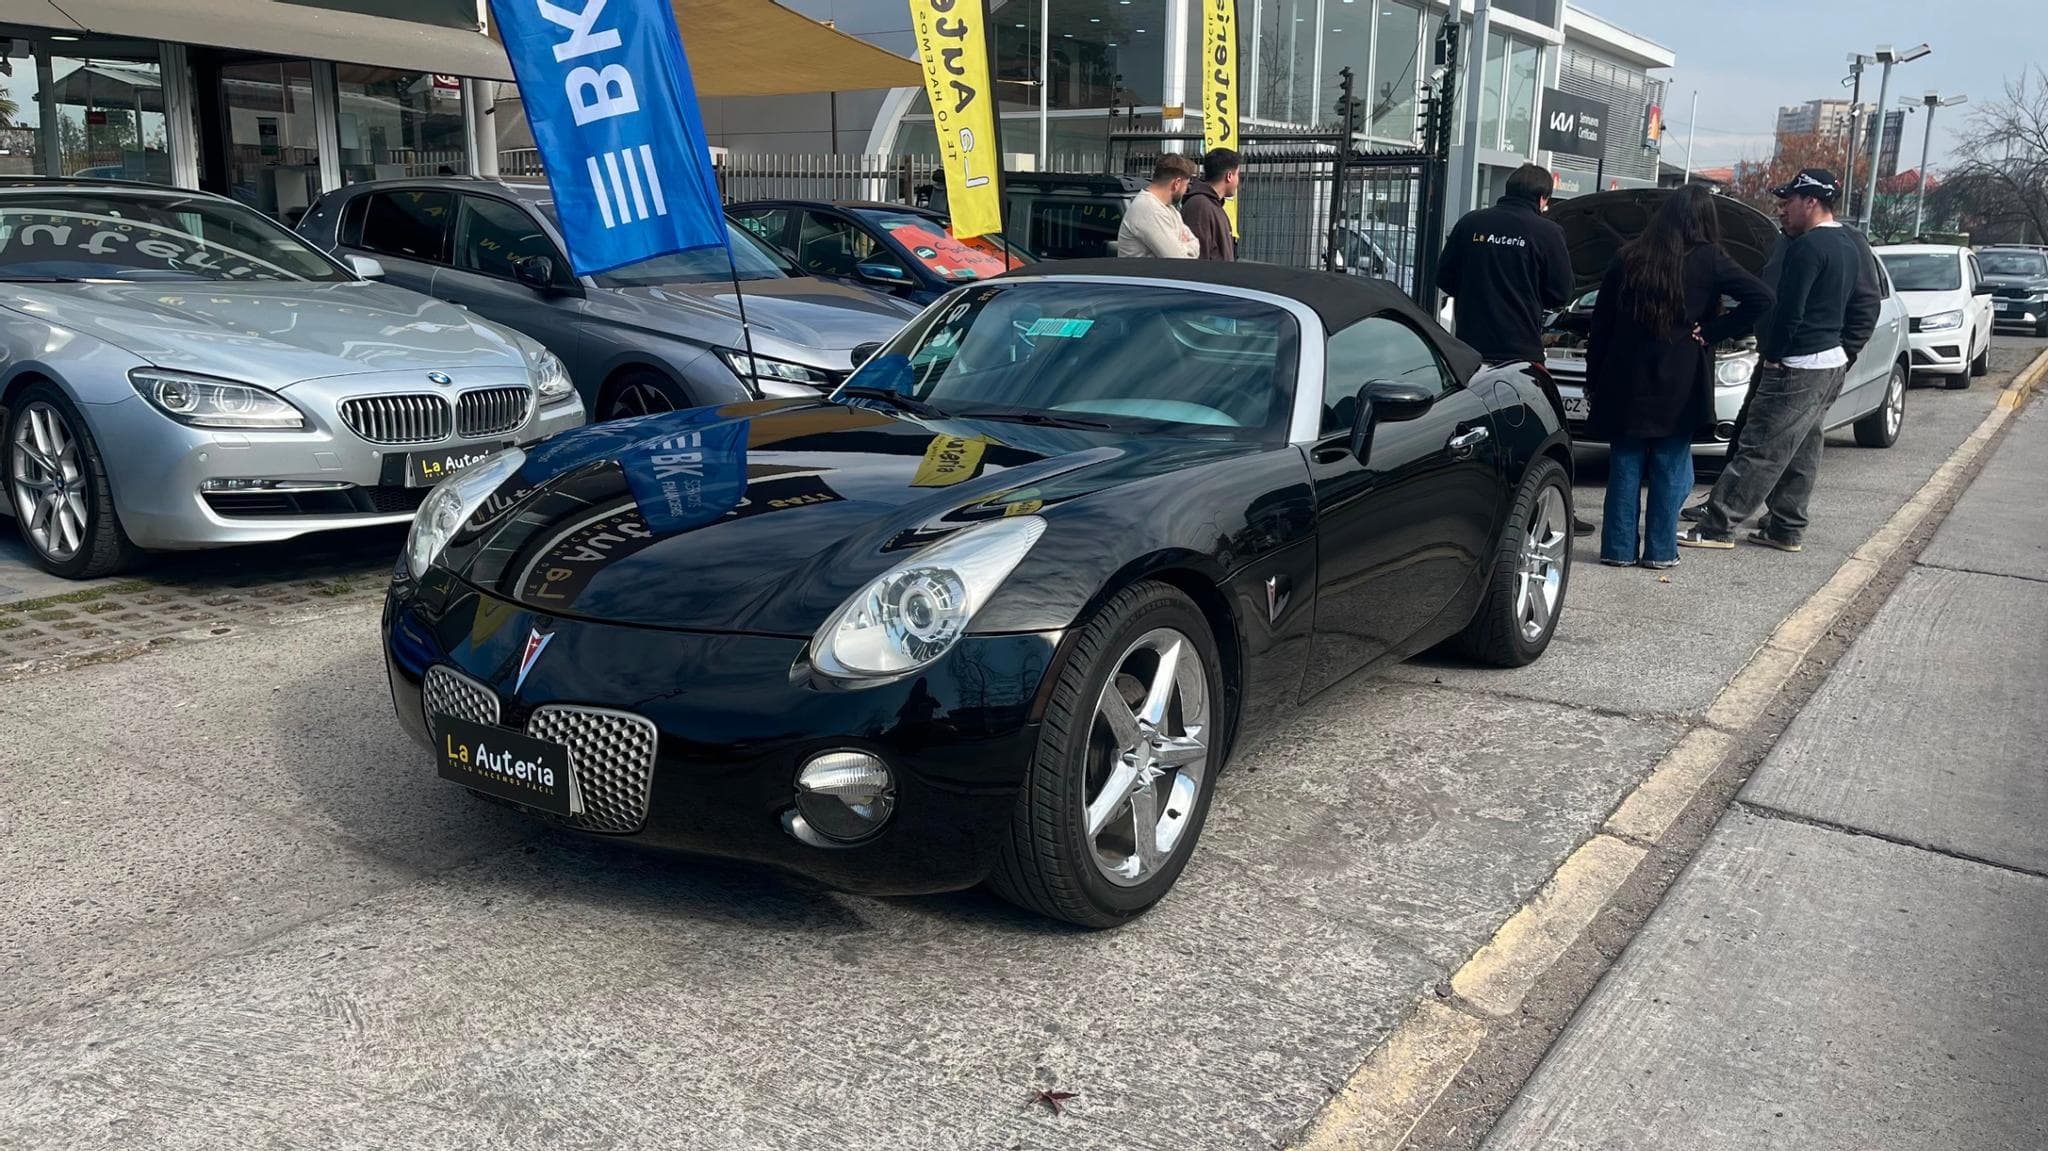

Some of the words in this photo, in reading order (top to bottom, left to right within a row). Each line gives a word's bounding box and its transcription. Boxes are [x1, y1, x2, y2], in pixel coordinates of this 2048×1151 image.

[422, 459, 441, 474] La
[447, 733, 468, 763] La
[475, 743, 554, 787] Autería
